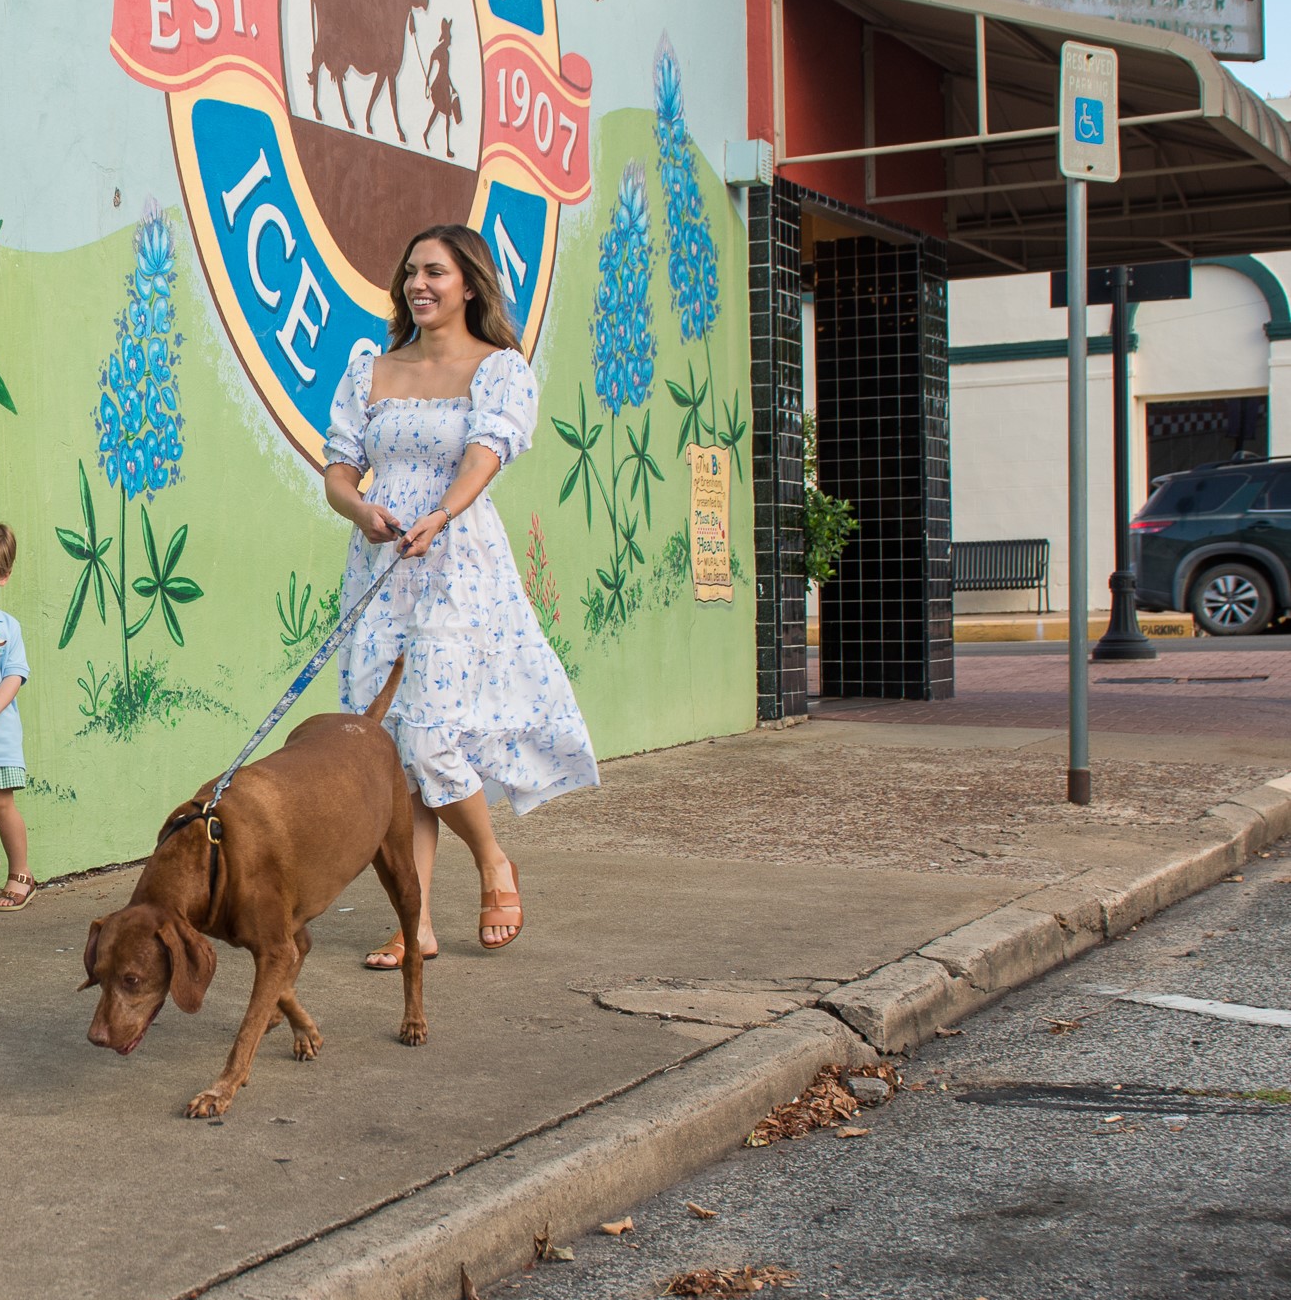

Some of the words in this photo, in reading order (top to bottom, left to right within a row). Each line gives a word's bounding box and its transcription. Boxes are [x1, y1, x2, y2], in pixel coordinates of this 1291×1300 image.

[1066, 51, 1113, 76] RESERVED
[1068, 75, 1110, 97] PARKING
[497, 68, 578, 174] 1907
[222, 153, 330, 383] ICE
[1141, 625, 1184, 636] PARKING
